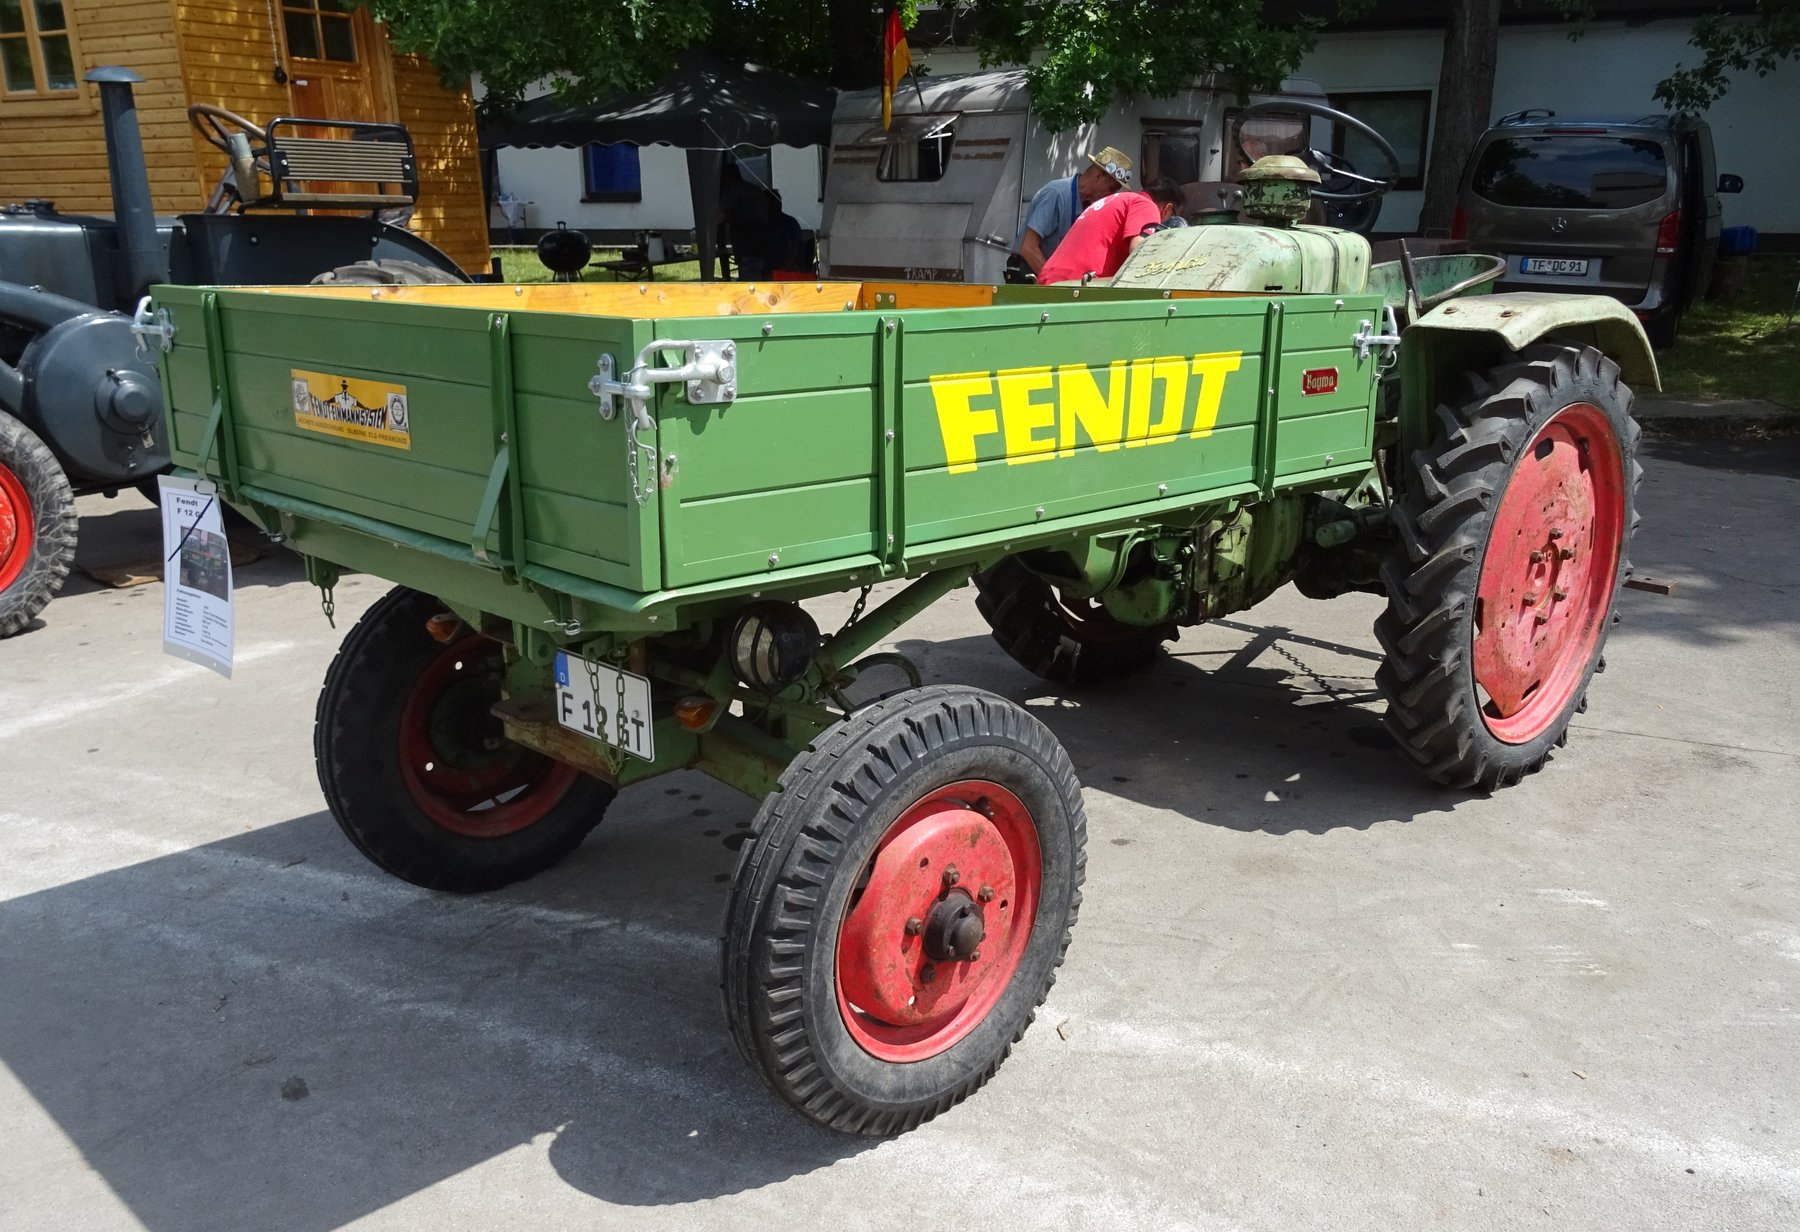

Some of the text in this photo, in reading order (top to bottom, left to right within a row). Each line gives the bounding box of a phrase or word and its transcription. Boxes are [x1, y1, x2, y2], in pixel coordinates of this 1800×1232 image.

[1532, 259, 1546, 270] TF
[1569, 261, 1582, 272] 91
[929, 350, 1243, 475] FENDT
[176, 497, 198, 507] Fendt
[177, 507, 183, 515] F
[184, 509, 194, 517] 12
[560, 672, 566, 683] D
[562, 692, 573, 722] F
